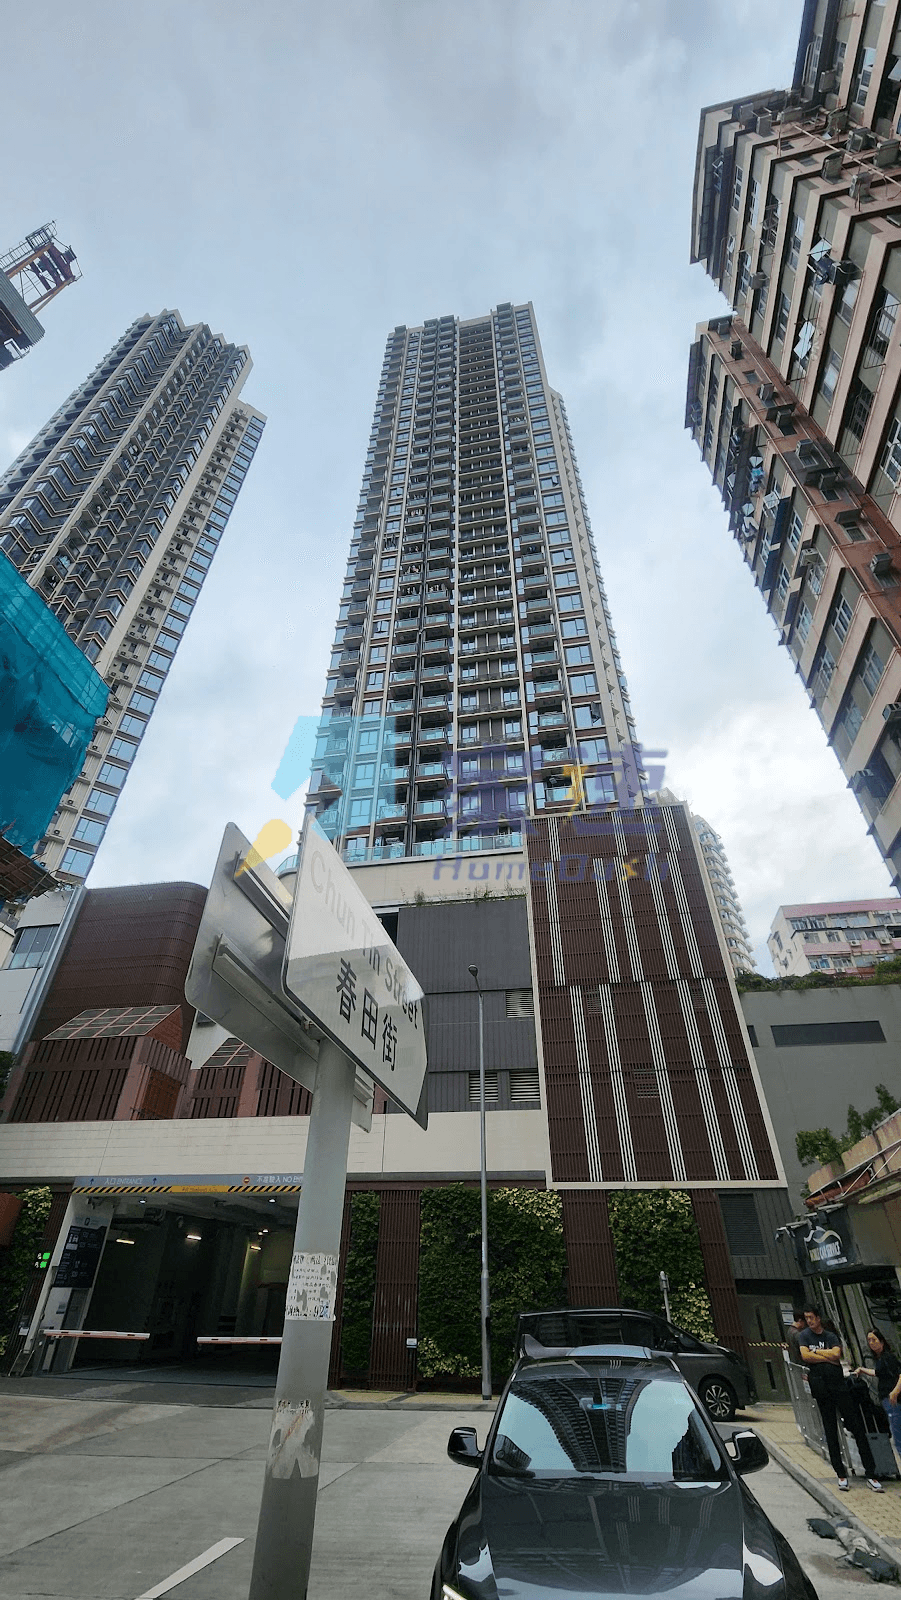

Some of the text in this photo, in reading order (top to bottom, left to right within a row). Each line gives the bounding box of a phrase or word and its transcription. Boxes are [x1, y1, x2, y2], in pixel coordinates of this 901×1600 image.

[310, 851, 418, 1029] Chun Tin Street
[336, 958, 398, 1071] 春田街
[117, 1177, 143, 1185] ENTRANCE
[282, 1175, 293, 1183] NO
